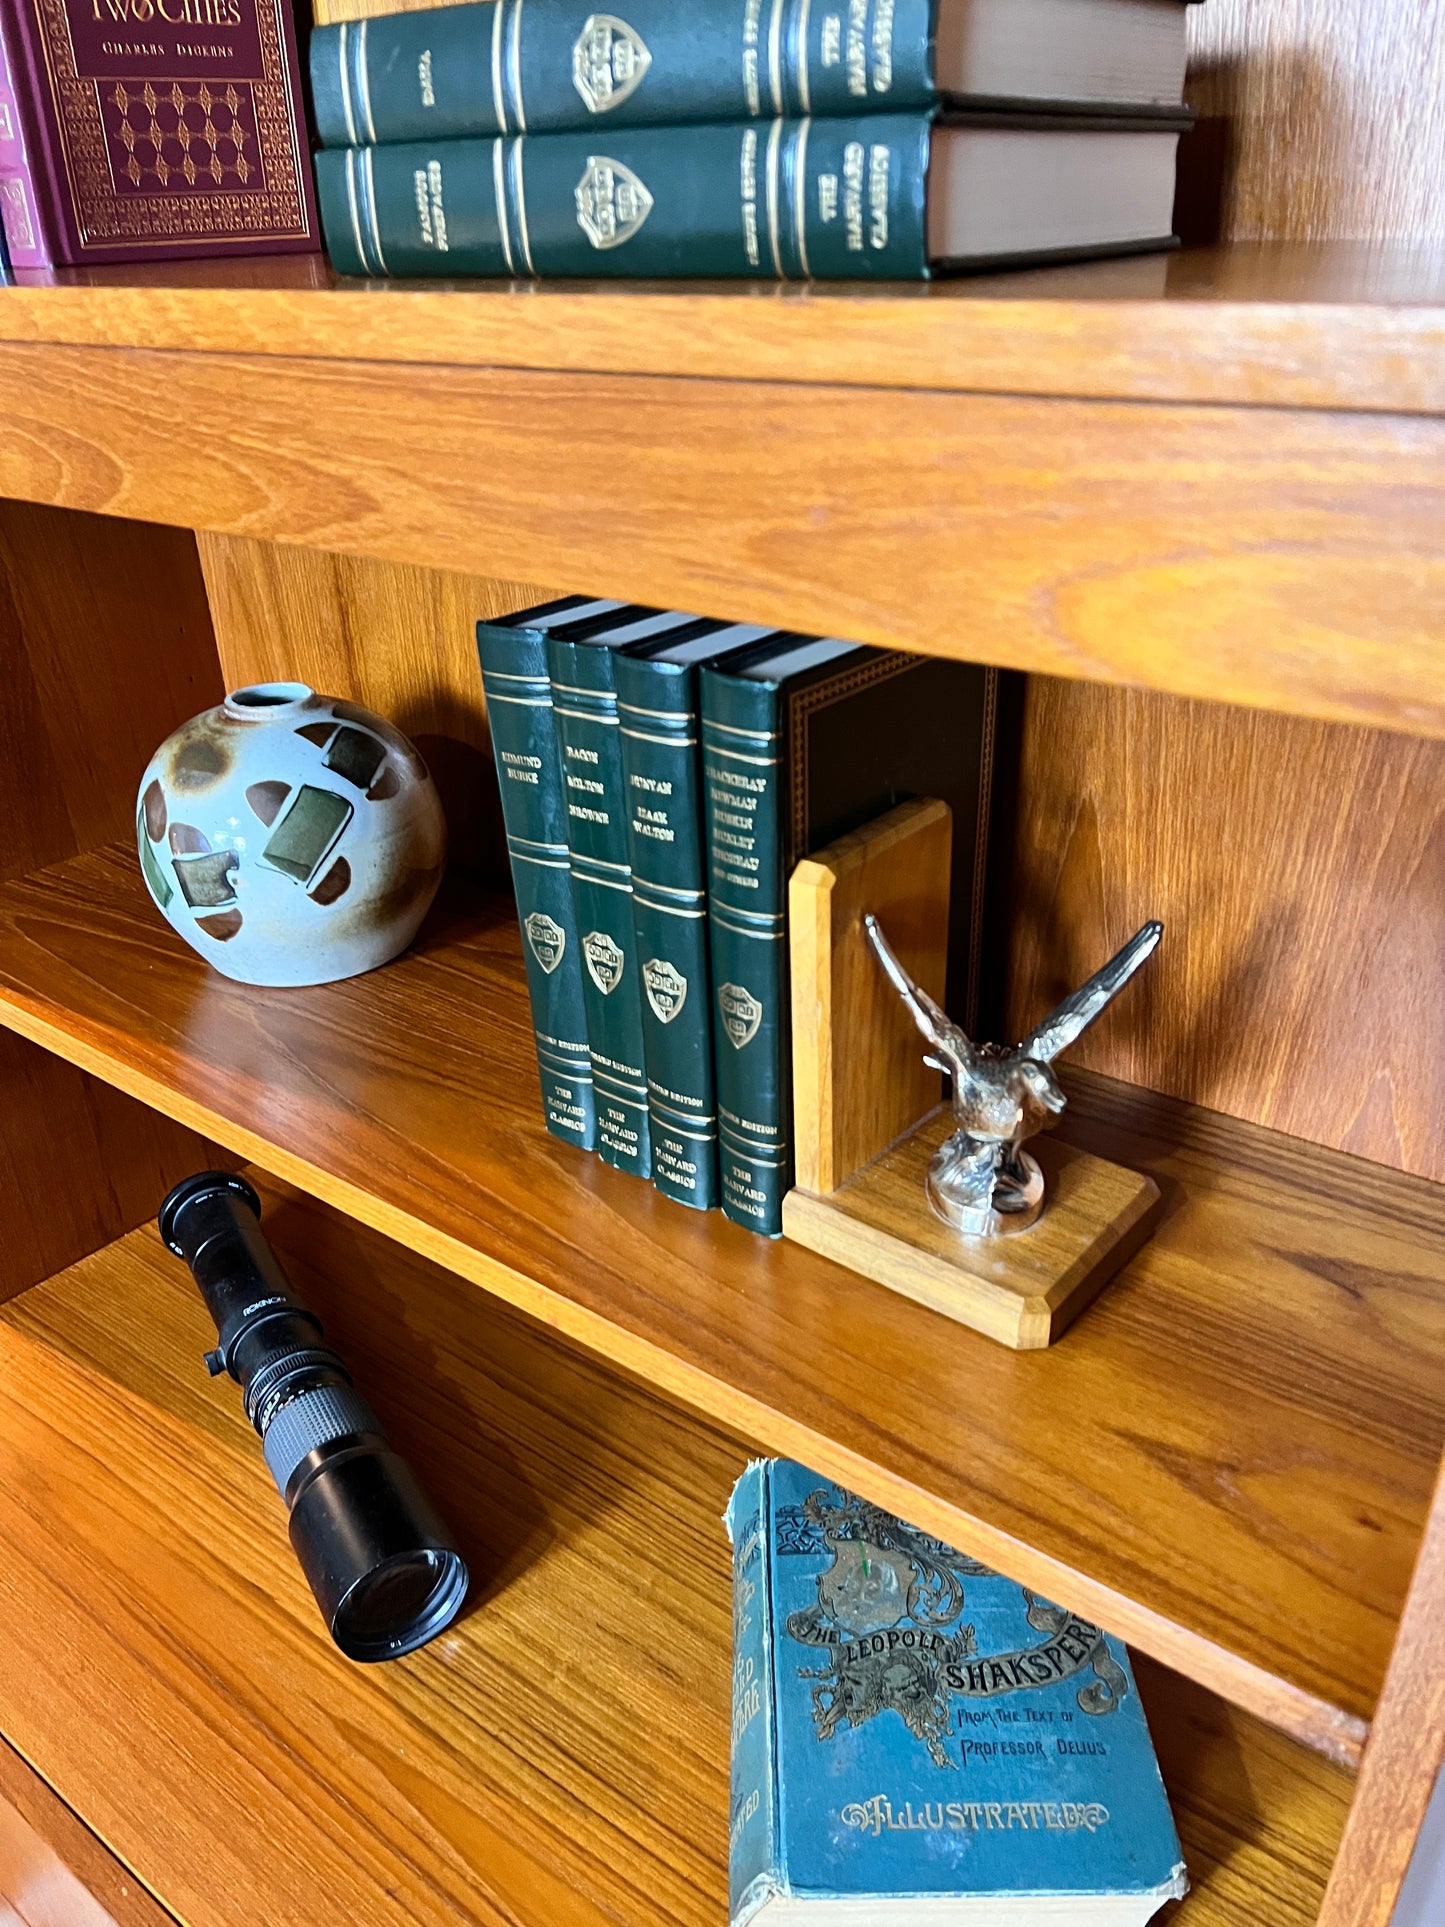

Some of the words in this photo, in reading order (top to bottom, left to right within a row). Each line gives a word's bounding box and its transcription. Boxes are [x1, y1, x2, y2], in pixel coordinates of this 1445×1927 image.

[102, 41, 165, 56] CHARLES
[176, 43, 234, 58] DICKENS
[818, 173, 838, 223] THE
[843, 141, 864, 250] HARVARD
[870, 144, 890, 249] CLASSICS
[501, 751, 542, 769] EDMUND
[632, 819, 675, 842] WALTON
[550, 1111, 586, 1133] CLASSICS
[741, 1119, 778, 1136] EDITION
[664, 1139, 684, 1155] THE
[655, 1146, 698, 1175] HARVARD
[657, 1164, 696, 1190] CLASSICS
[732, 1165, 752, 1183] THE
[723, 1174, 767, 1203] HARVARD
[724, 1191, 766, 1219] CLASSICS
[242, 1296, 287, 1317] ROKINON
[801, 1623, 840, 1644] THE
[957, 1708, 998, 1729] FROM
[995, 1708, 1020, 1722] THE
[1023, 1707, 1054, 1722] TEXT
[960, 1739, 1048, 1767] PROFESSOR
[869, 1794, 1080, 1837] ILLUSTRATED
